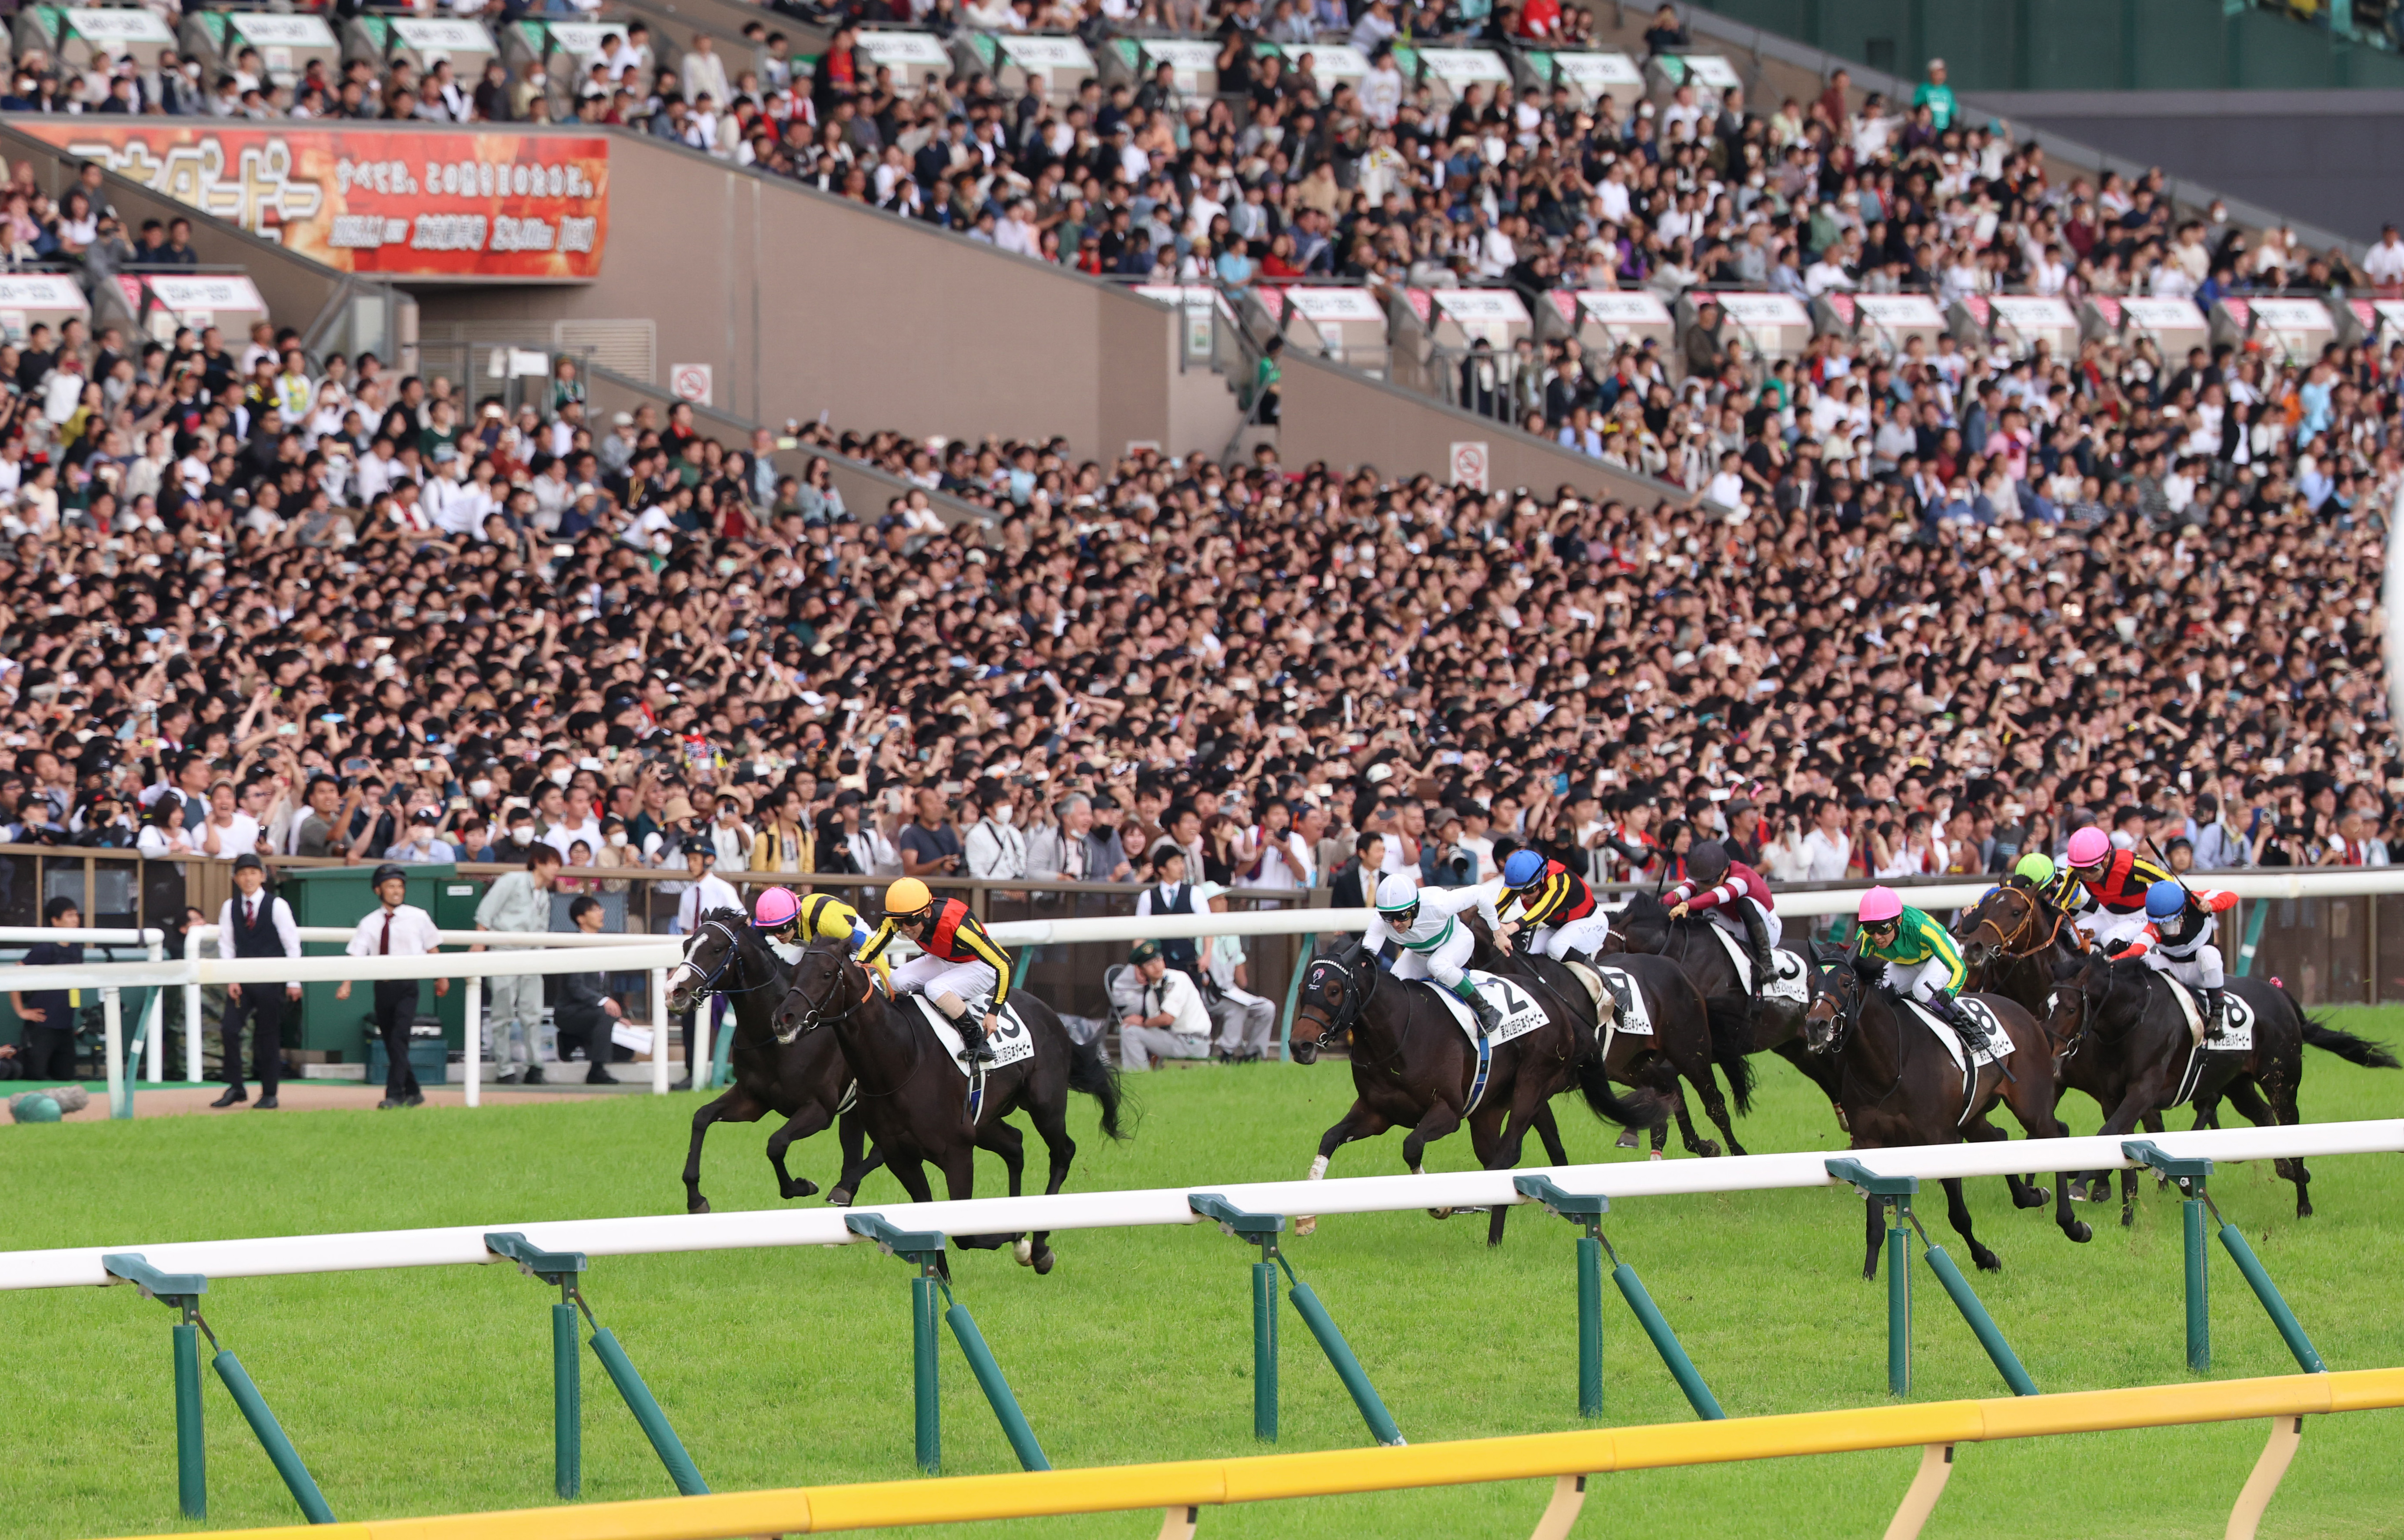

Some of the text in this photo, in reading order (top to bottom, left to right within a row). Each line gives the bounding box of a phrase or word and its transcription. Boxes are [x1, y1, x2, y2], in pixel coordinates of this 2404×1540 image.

[1487, 977, 1529, 1015] 2
[1500, 1011, 1543, 1039] 第92回日本ダービー
